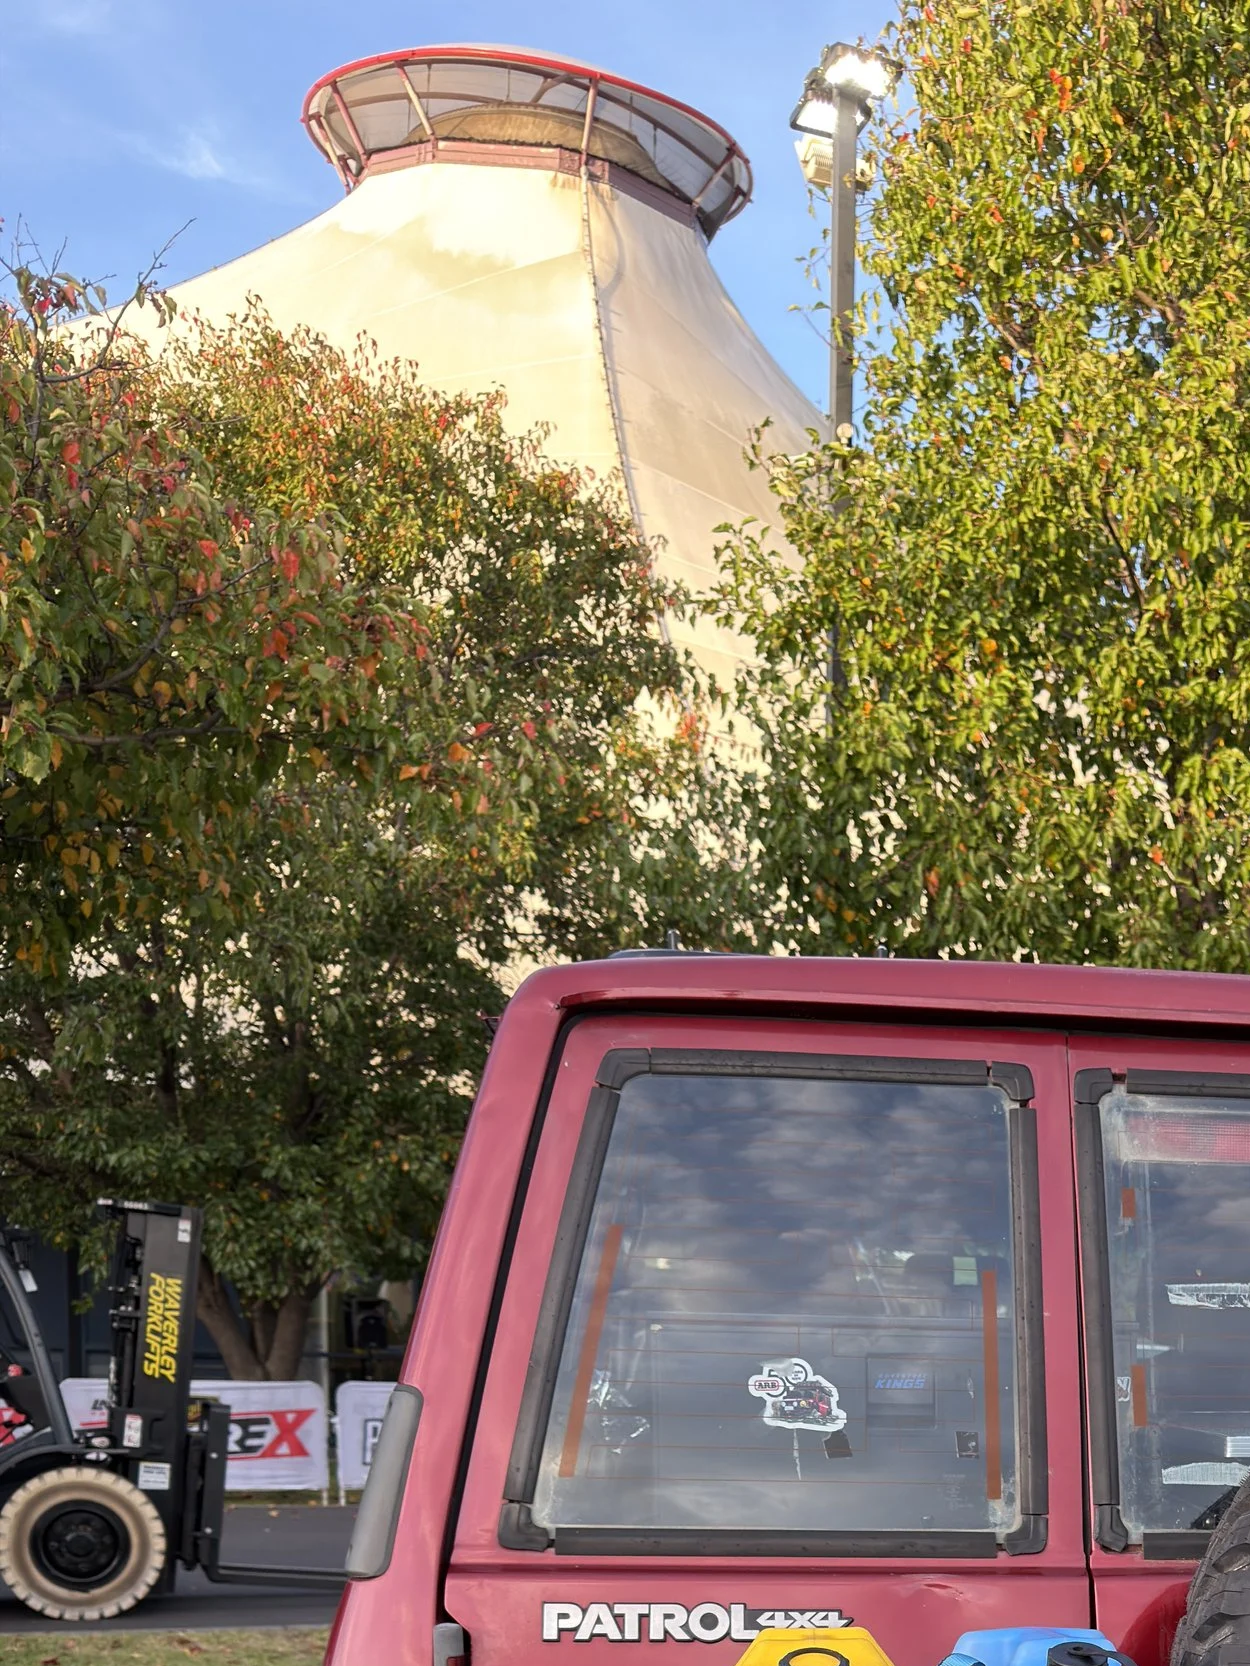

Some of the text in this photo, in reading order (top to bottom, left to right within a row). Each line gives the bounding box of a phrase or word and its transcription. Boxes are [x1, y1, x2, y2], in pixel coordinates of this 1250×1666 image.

[143, 1271, 165, 1379] FORKLIFTS
[160, 1277, 182, 1384] WAVERLEY
[756, 1382, 777, 1390] ARB
[874, 1379, 925, 1389] KINGS
[541, 1602, 760, 1642] PATROL
